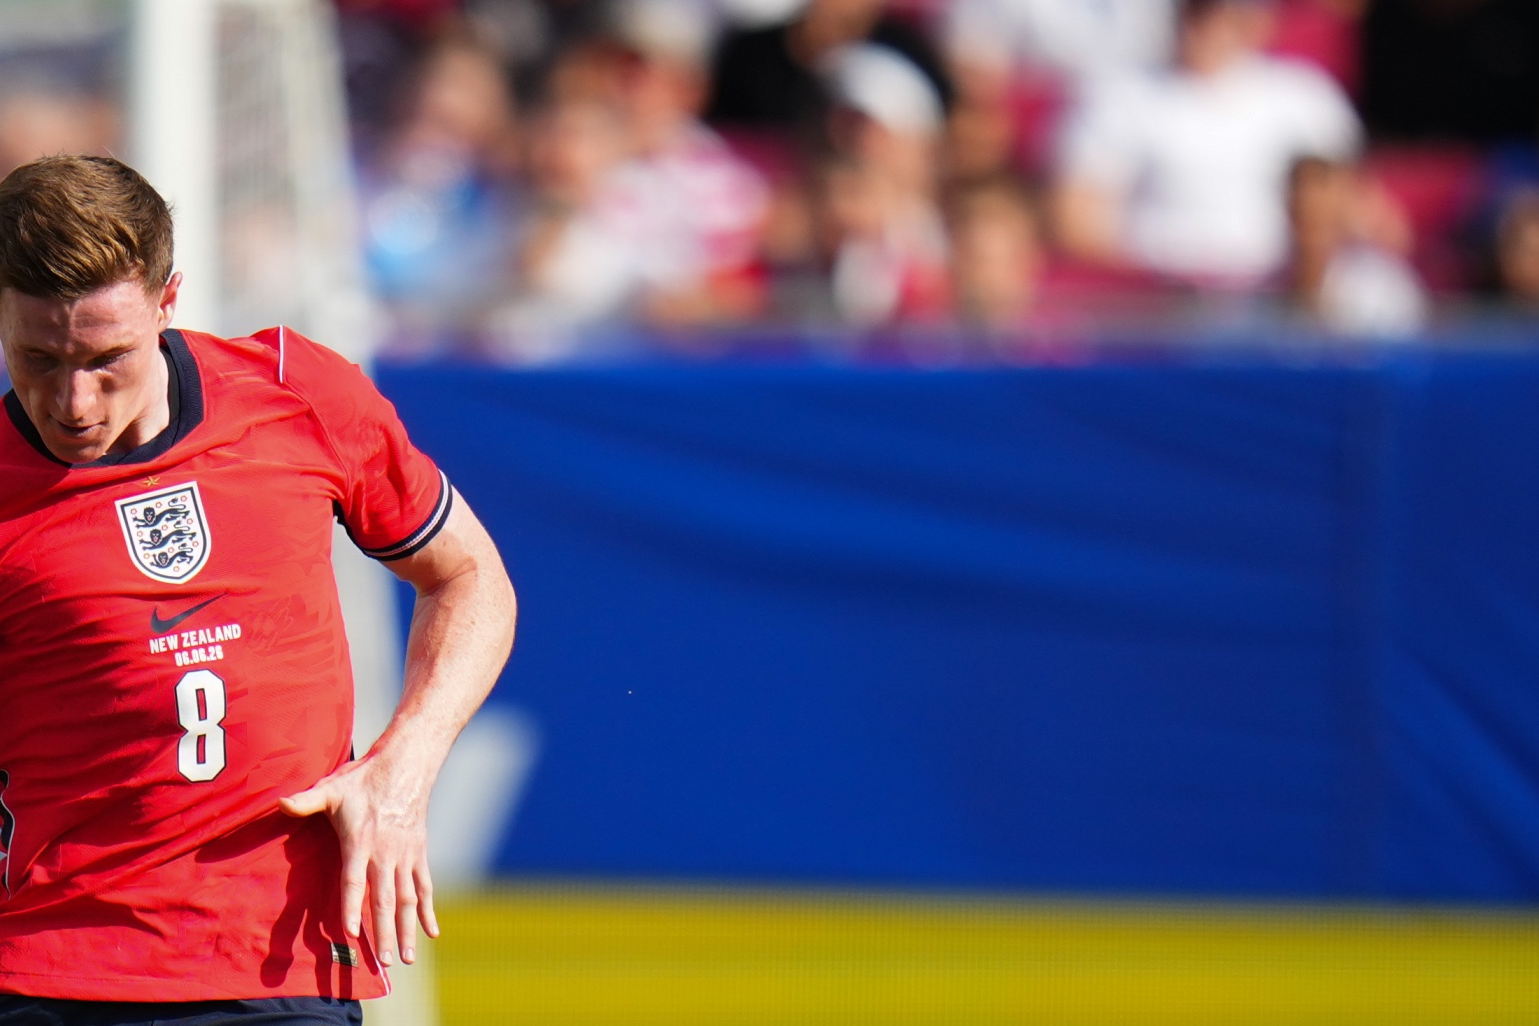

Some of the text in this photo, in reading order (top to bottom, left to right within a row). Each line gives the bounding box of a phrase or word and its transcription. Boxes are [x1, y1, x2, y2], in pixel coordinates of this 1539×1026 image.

[149, 624, 241, 654] NEW ZEALAND
[175, 645, 223, 666] 06.06.26
[174, 668, 227, 783] 8
